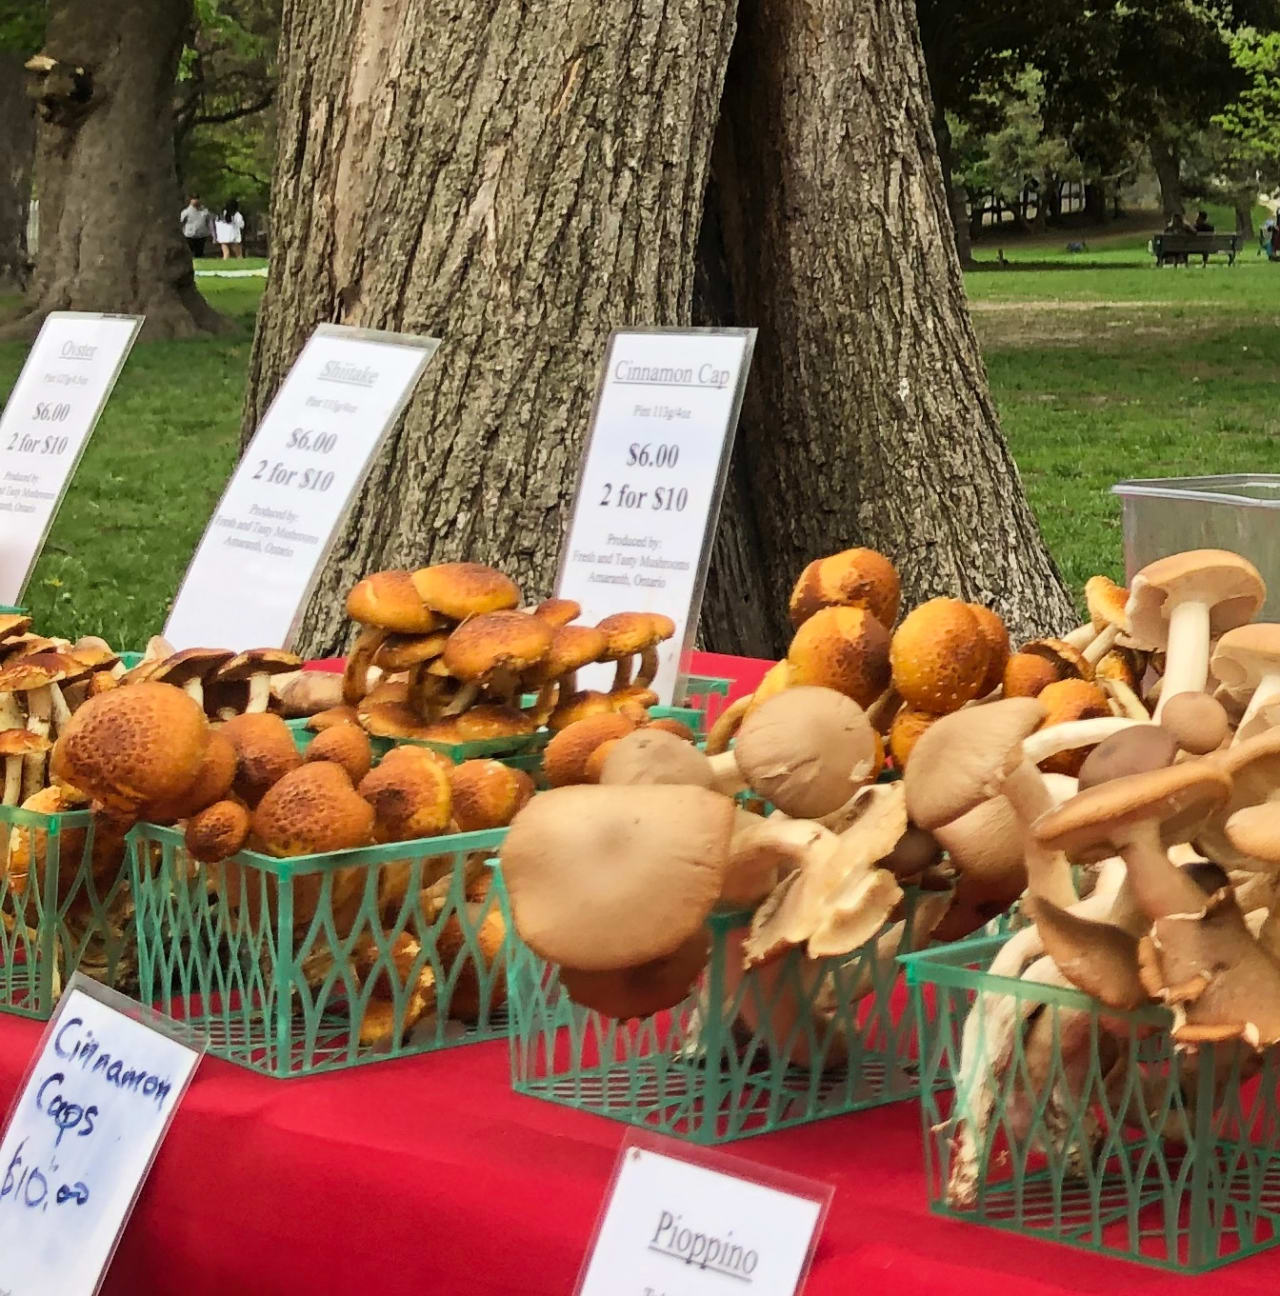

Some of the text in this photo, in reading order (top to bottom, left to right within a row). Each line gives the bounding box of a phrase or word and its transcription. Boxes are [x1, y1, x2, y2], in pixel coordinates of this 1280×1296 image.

[614, 360, 730, 389] Cinnamon Cap
[32, 402, 70, 421] $6.00
[6, 432, 69, 455] 2 for $10
[286, 428, 338, 454] $6.00
[626, 442, 679, 468] $6.00
[252, 459, 335, 492] 2 for $10
[600, 483, 688, 512] 2 for $10
[606, 533, 647, 548] Produced
[55, 1017, 171, 1114] Cinnamon
[36, 1073, 99, 1147] Caps
[652, 1210, 759, 1275] Pioppino
